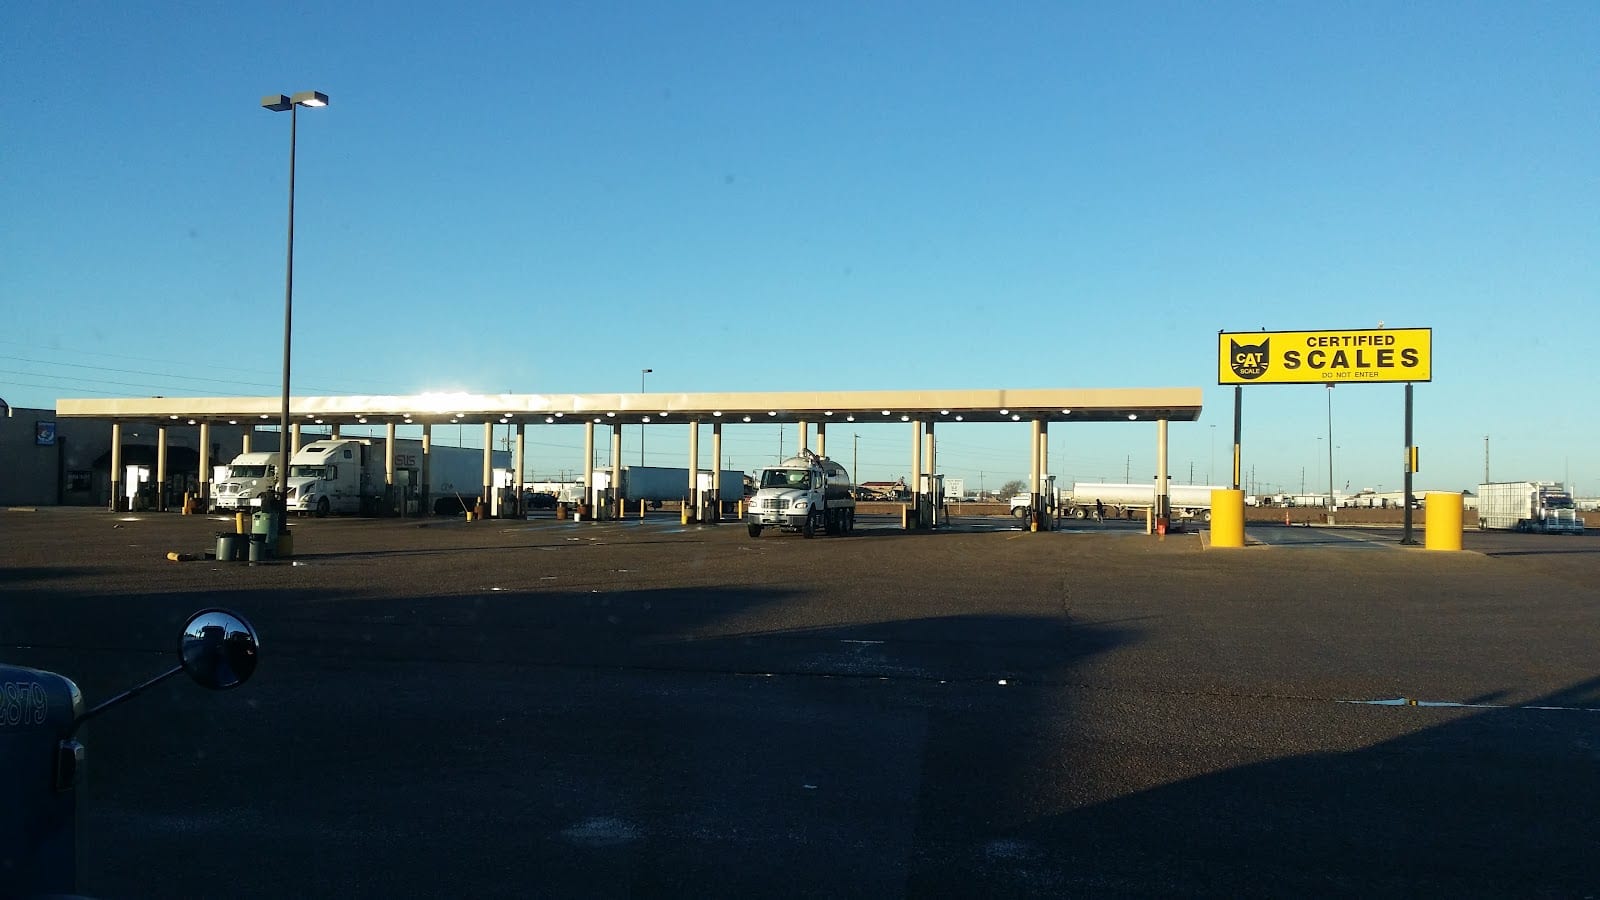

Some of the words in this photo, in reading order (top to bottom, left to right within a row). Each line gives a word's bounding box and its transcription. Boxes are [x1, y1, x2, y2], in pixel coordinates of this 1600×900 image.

[1306, 335, 1395, 347] CERTIFIED
[1236, 352, 1263, 367] CAT
[1283, 348, 1419, 369] SCALES
